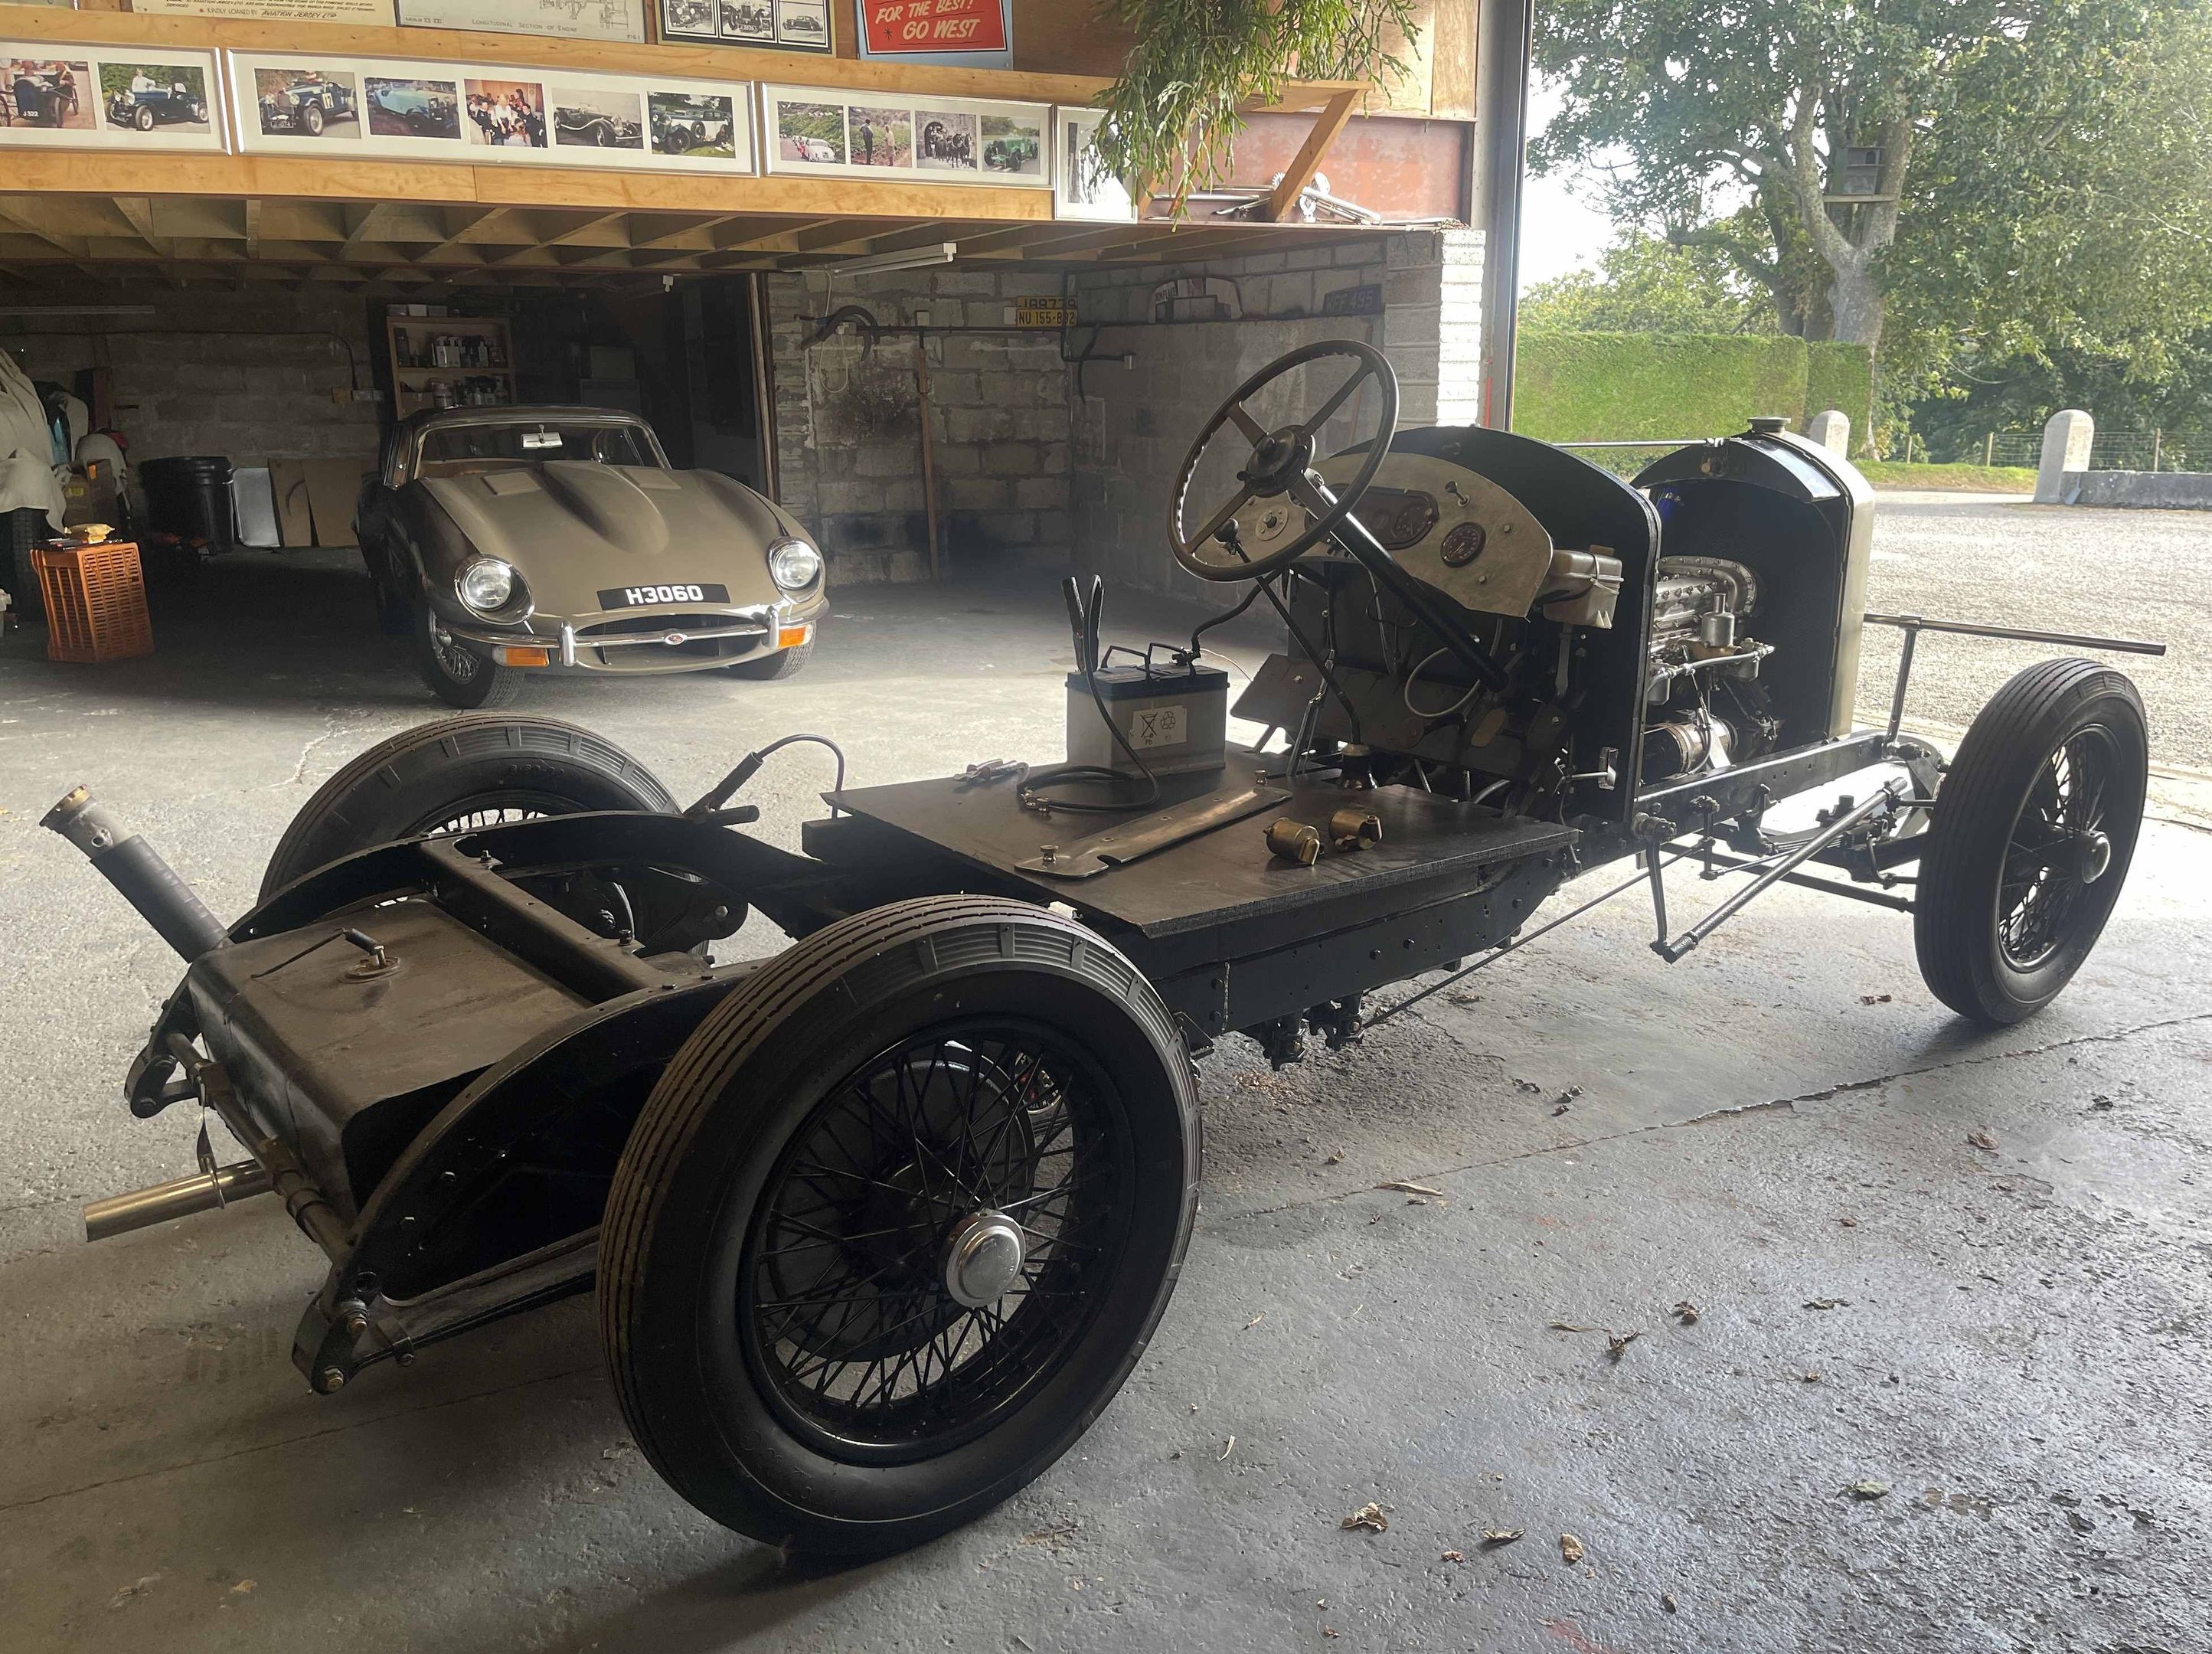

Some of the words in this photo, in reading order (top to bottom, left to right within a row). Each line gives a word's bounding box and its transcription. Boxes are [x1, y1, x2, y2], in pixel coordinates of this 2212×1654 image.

[875, 5, 903, 24] FOR
[908, 2, 931, 18] THE
[936, 0, 975, 12] BEST!
[472, 18, 513, 28] LONGITUDINAL
[903, 21, 930, 40] GO
[933, 19, 980, 38] WEST
[1019, 312, 1031, 325] NU
[626, 585, 704, 605] H3060
